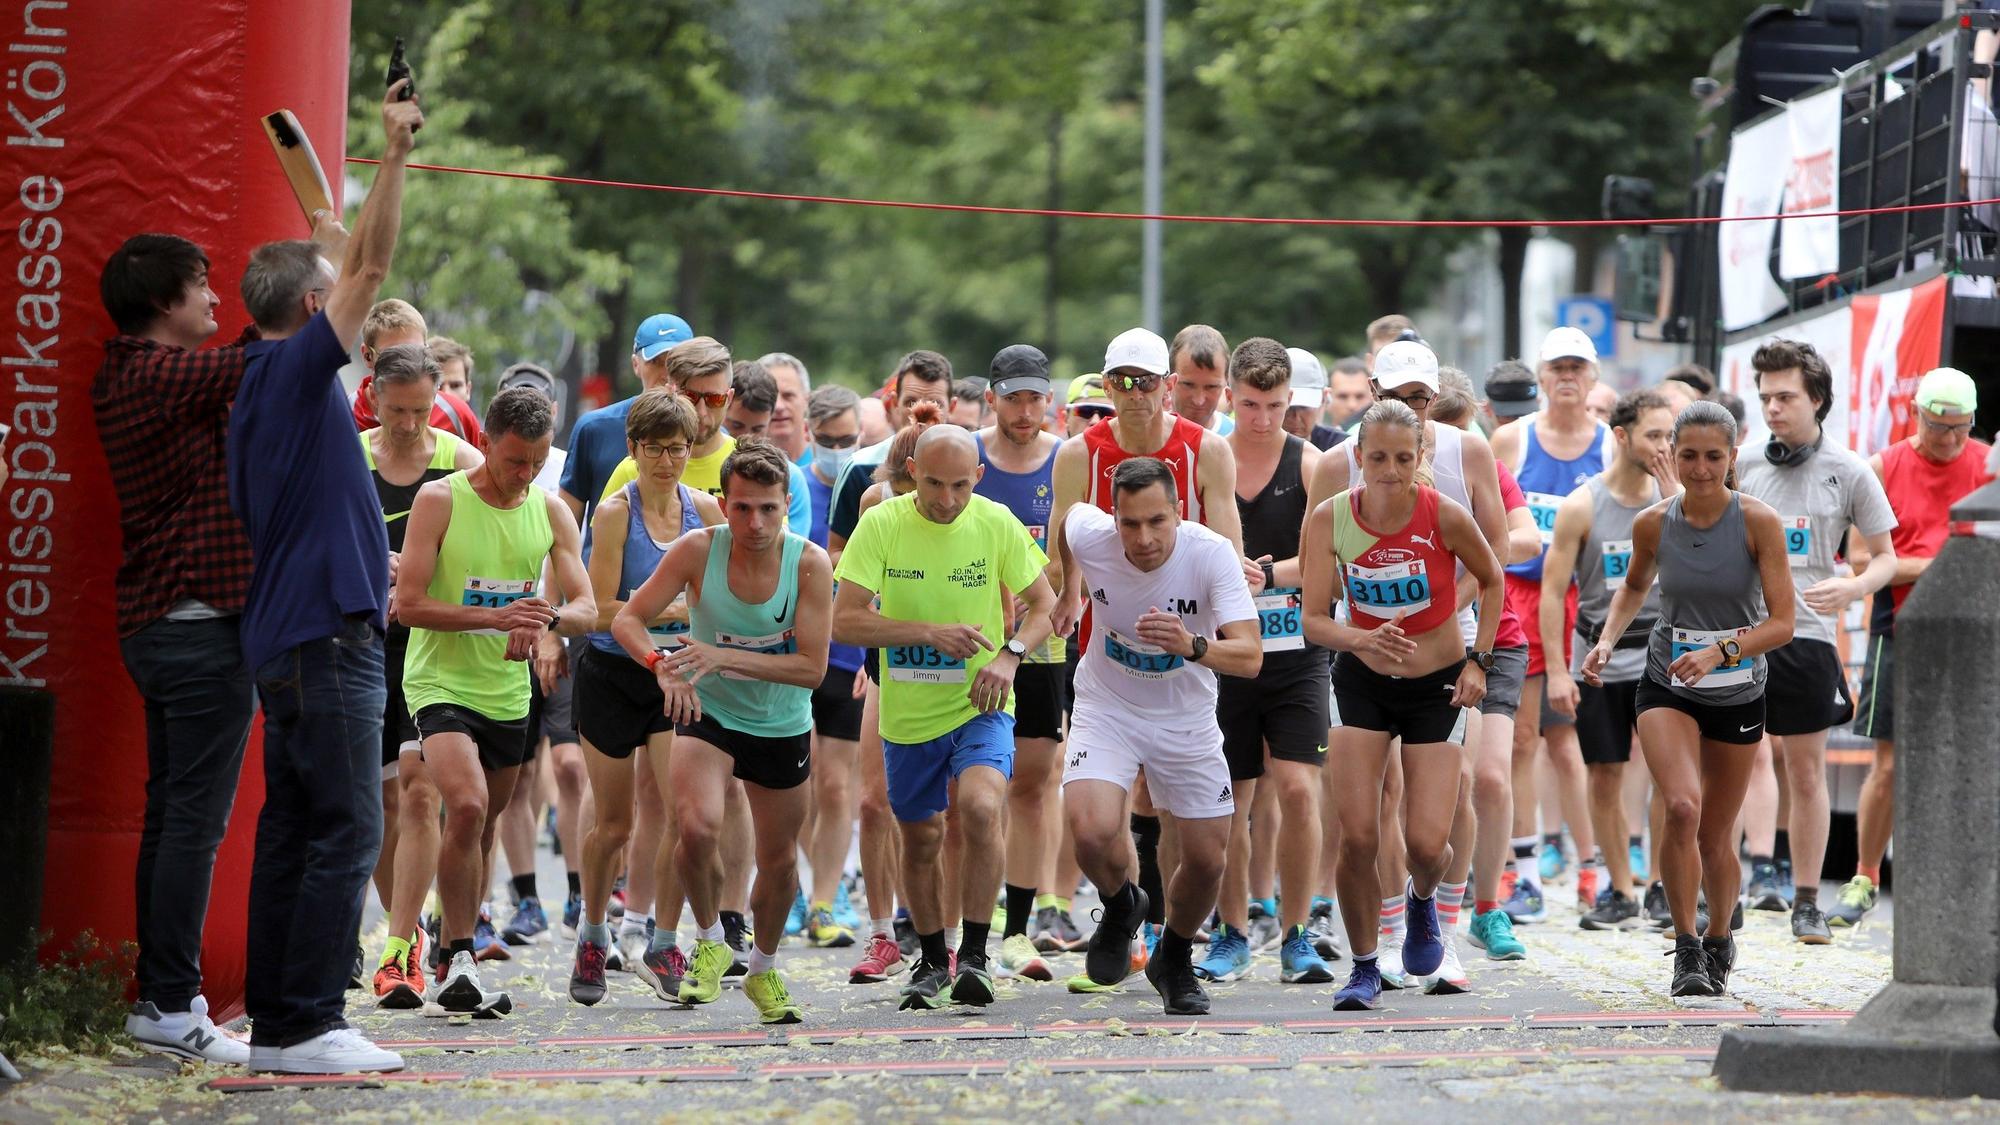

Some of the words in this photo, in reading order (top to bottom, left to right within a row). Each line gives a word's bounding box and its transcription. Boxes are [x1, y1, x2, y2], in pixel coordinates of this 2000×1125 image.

[7, 0, 68, 148] Köln
[0, 175, 71, 687] Kreissparkasse
[1353, 578, 1424, 604] 3110
[1110, 641, 1177, 671] 3017
[912, 670, 941, 682] Jimmy
[1125, 668, 1163, 680] Michael
[182, 1026, 216, 1051] N
